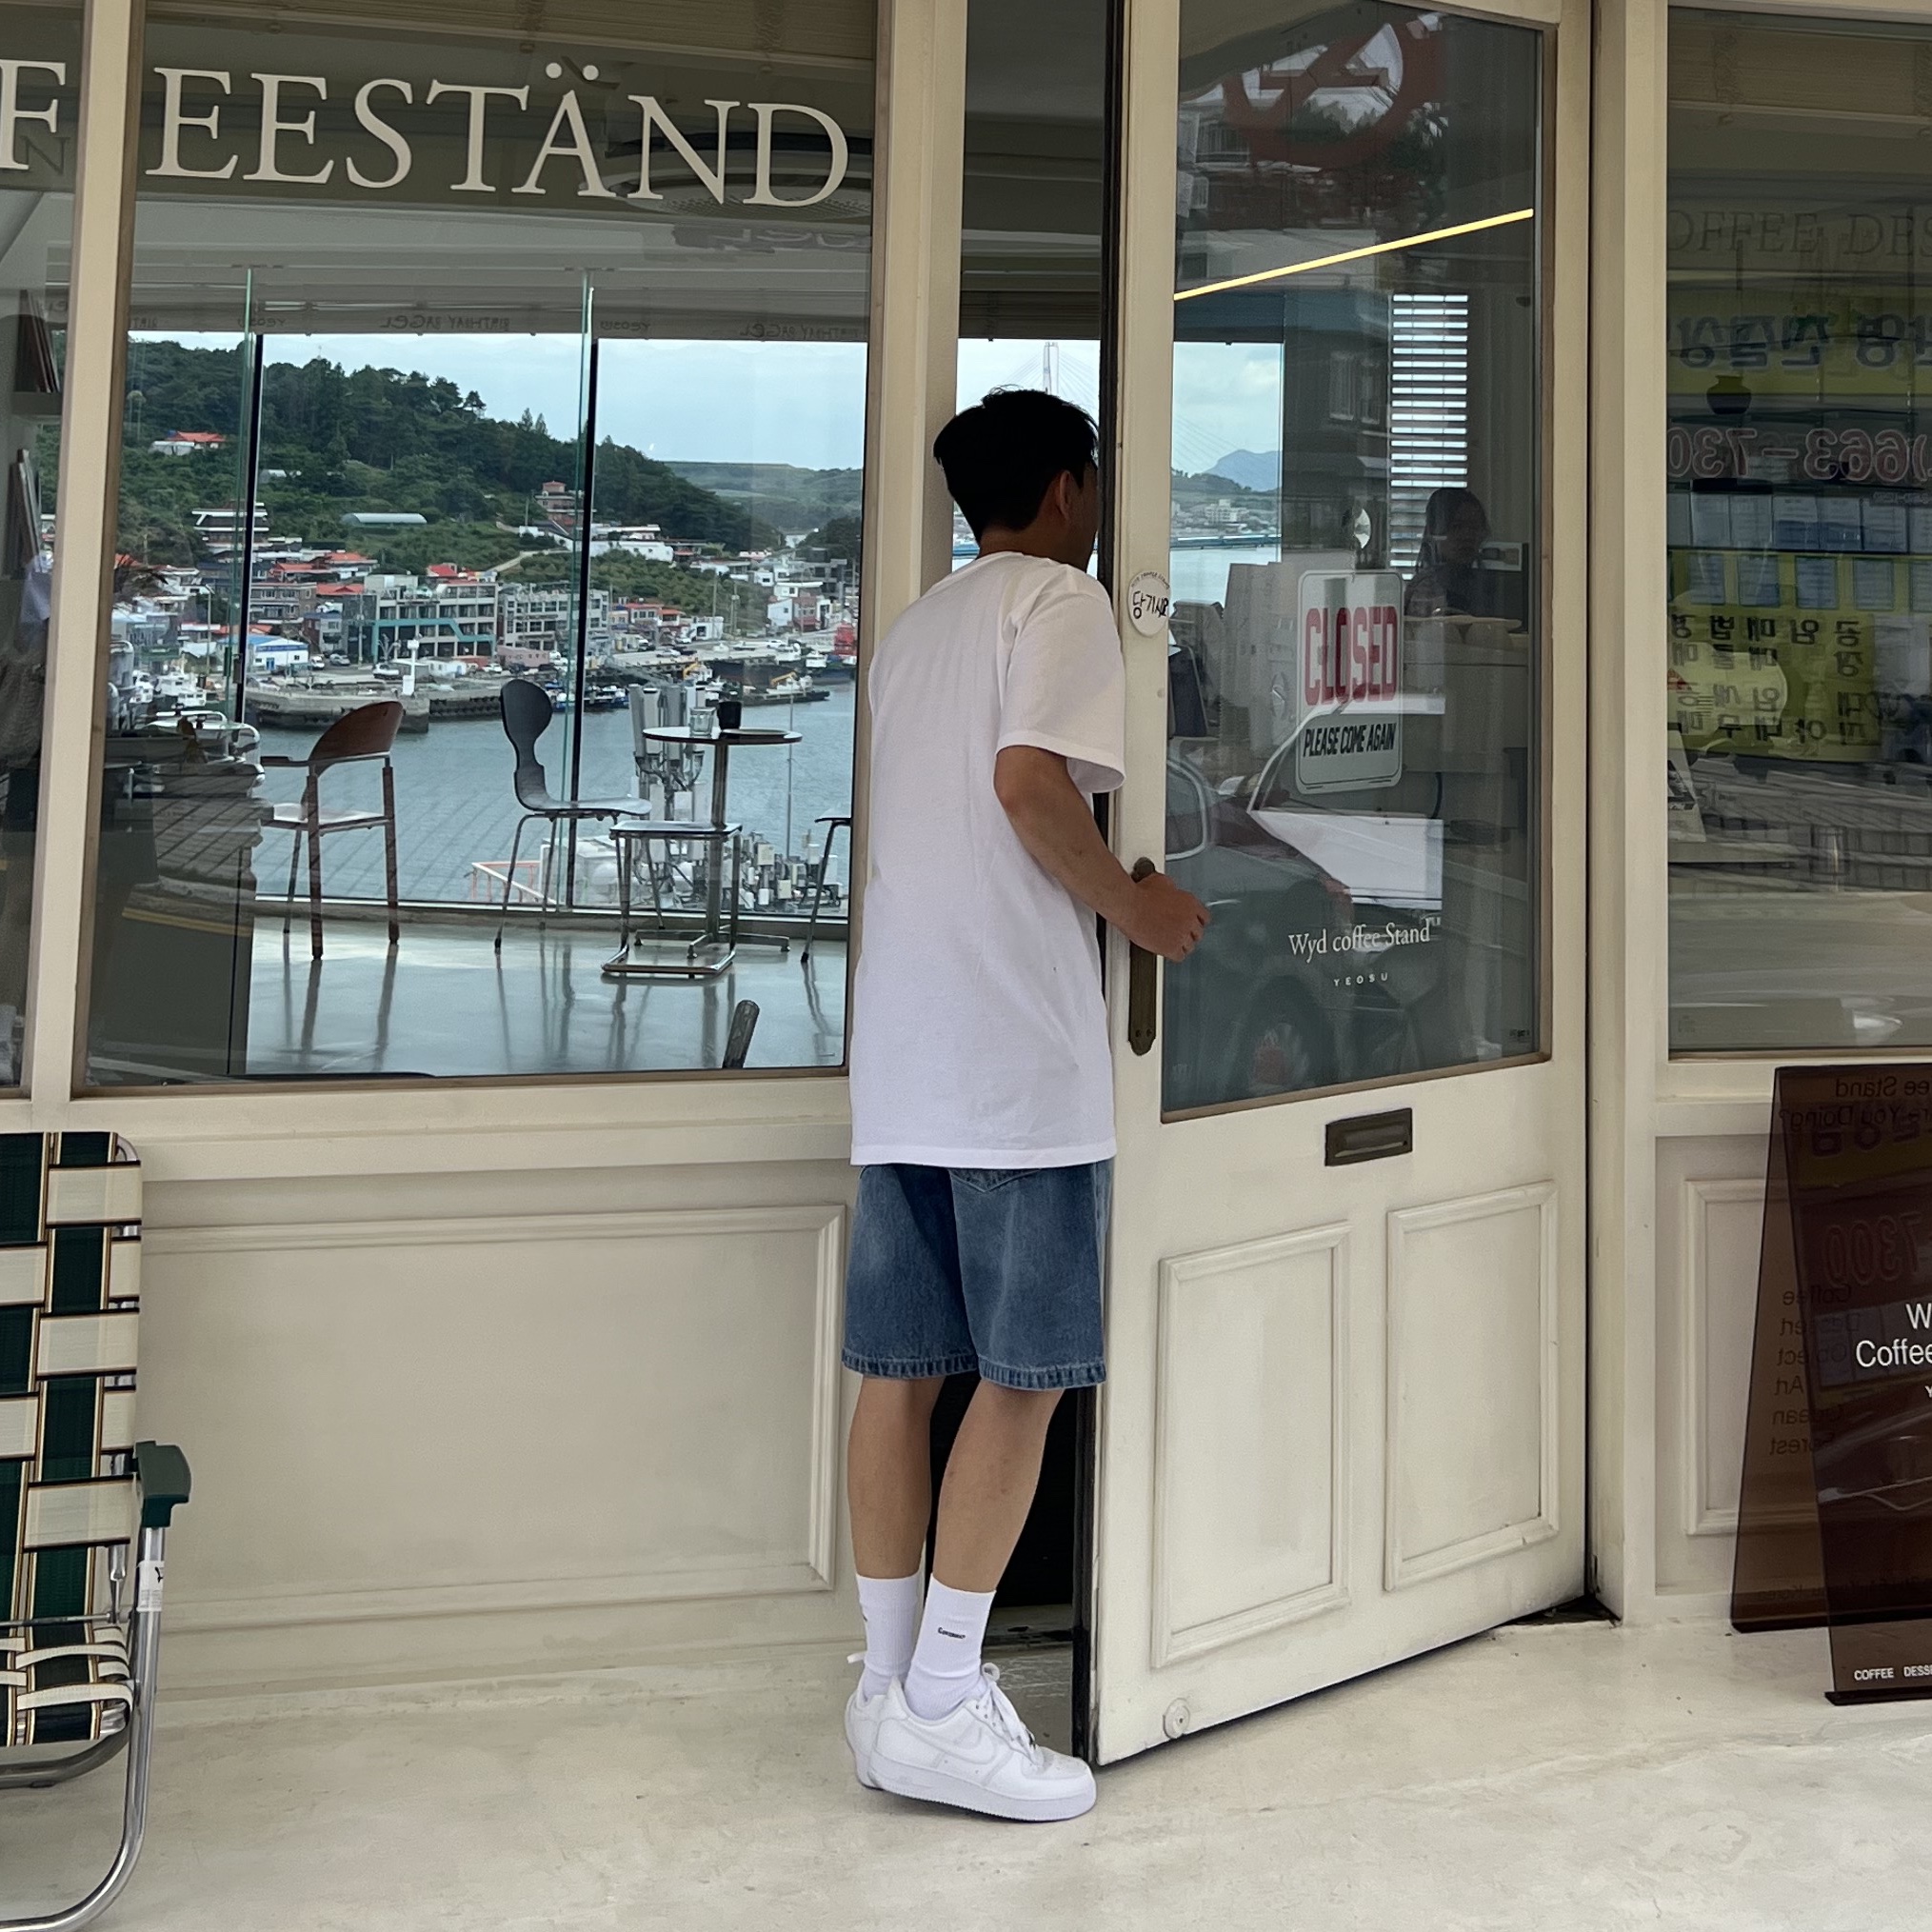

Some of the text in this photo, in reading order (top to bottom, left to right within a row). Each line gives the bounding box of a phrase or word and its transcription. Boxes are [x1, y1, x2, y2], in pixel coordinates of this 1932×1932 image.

[1305, 607, 1398, 706] CLOSED
[1303, 722, 1398, 758] PLEASE COME AGAIN
[1288, 927, 1327, 963] Wyd
[1333, 923, 1381, 952] coffee
[1385, 917, 1430, 946] Stand
[1333, 972, 1388, 987] YEOSU
[1854, 1667, 1895, 1682] COFFEE
